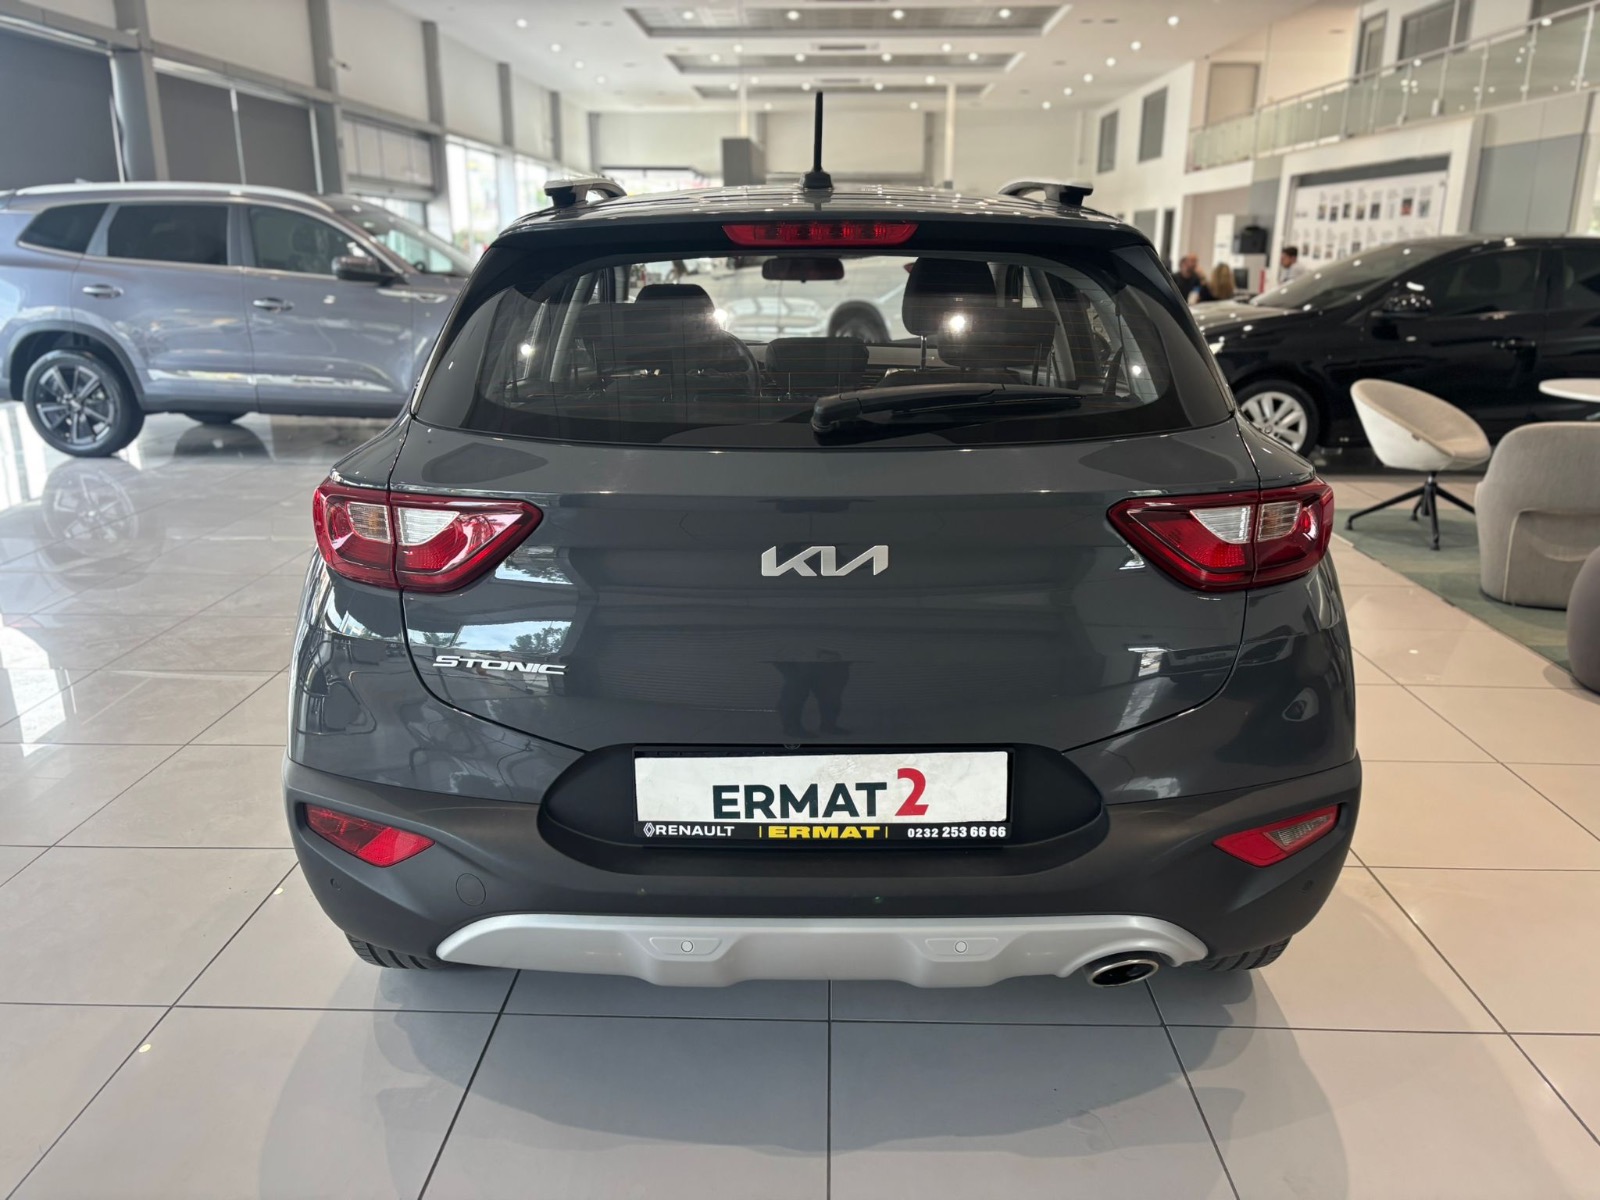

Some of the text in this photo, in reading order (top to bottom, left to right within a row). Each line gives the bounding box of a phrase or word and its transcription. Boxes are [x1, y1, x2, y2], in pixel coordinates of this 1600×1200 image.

[761, 545, 889, 577] KIA
[432, 655, 568, 676] STONIC
[712, 767, 929, 820] ERMAT 2
[655, 824, 735, 837] RENAULT
[768, 825, 880, 839] ERMAT
[907, 827, 939, 838] 0232
[941, 826, 967, 838] 253
